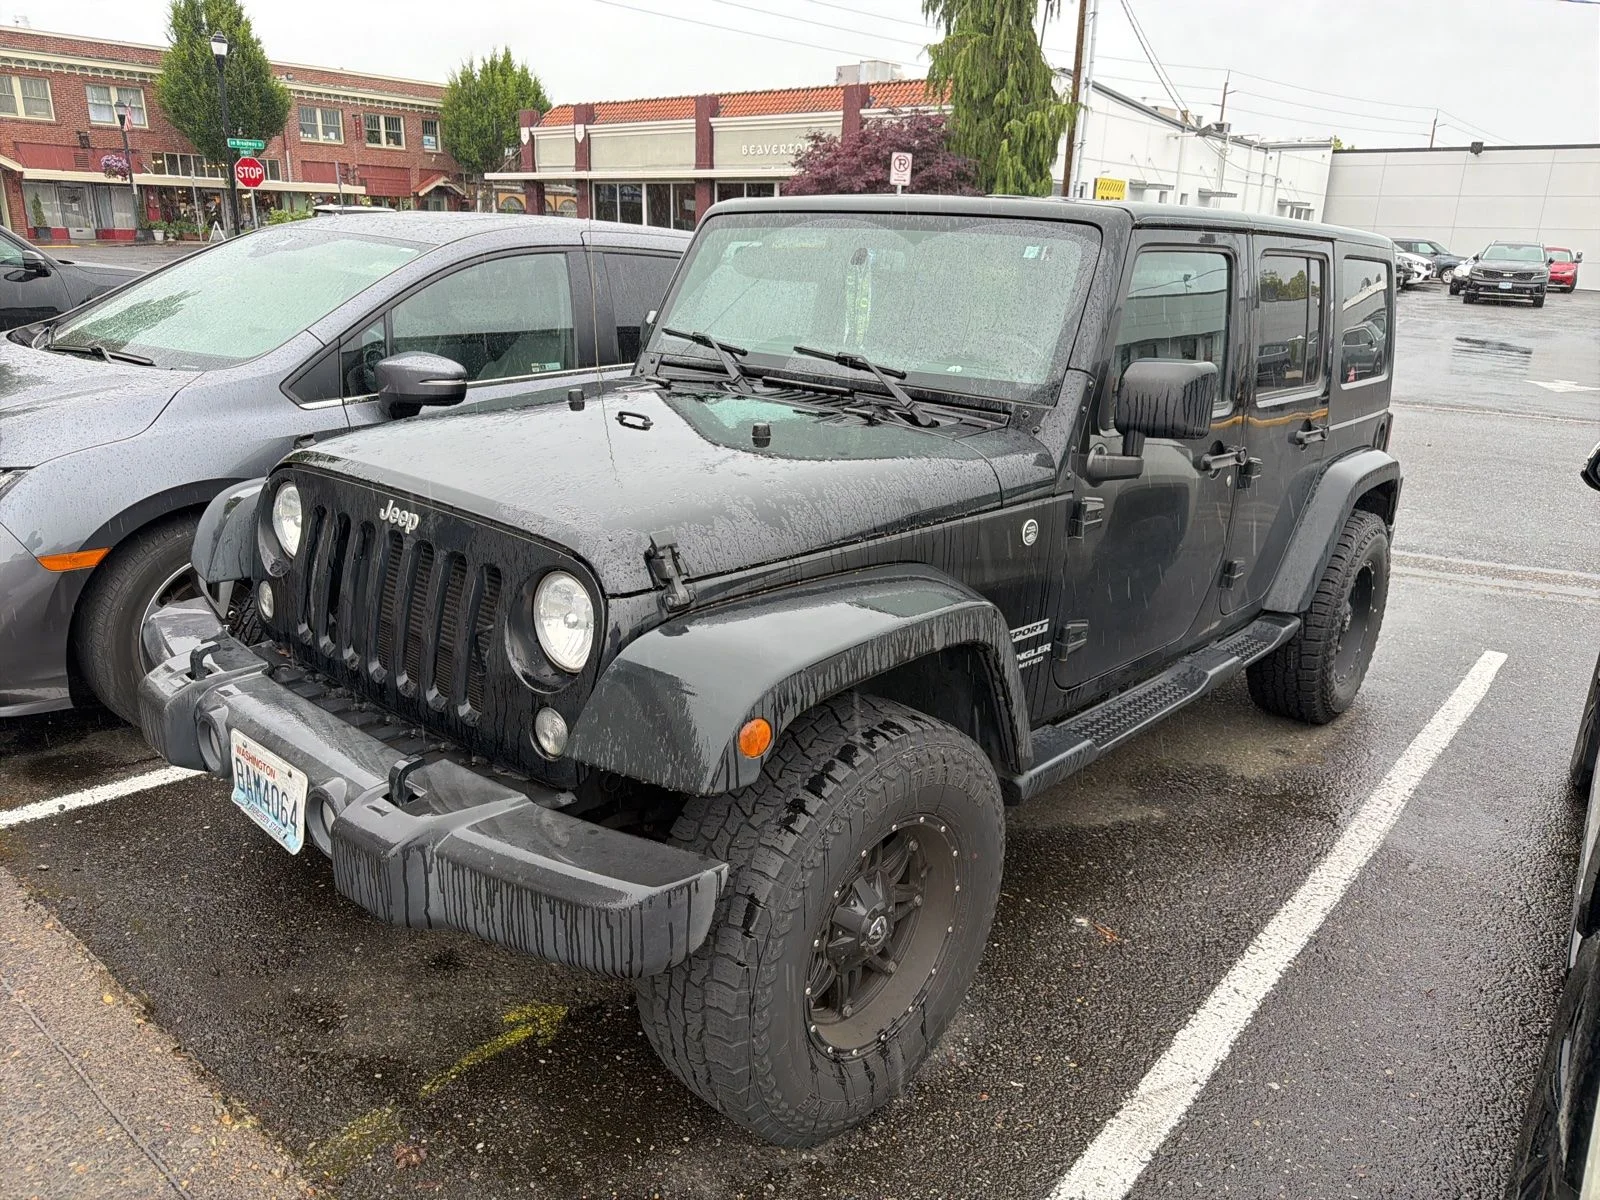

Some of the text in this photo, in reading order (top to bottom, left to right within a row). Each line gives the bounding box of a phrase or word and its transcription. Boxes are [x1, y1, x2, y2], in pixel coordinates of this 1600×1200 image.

[237, 166, 263, 179] STOP
[379, 499, 419, 535] Jeep
[1016, 642, 1052, 660] NGLER
[1018, 656, 1044, 669] MITED
[235, 744, 277, 780] WASHINGTON
[235, 756, 298, 838] BAM4064
[248, 803, 283, 836] EVERGREEN STATE
